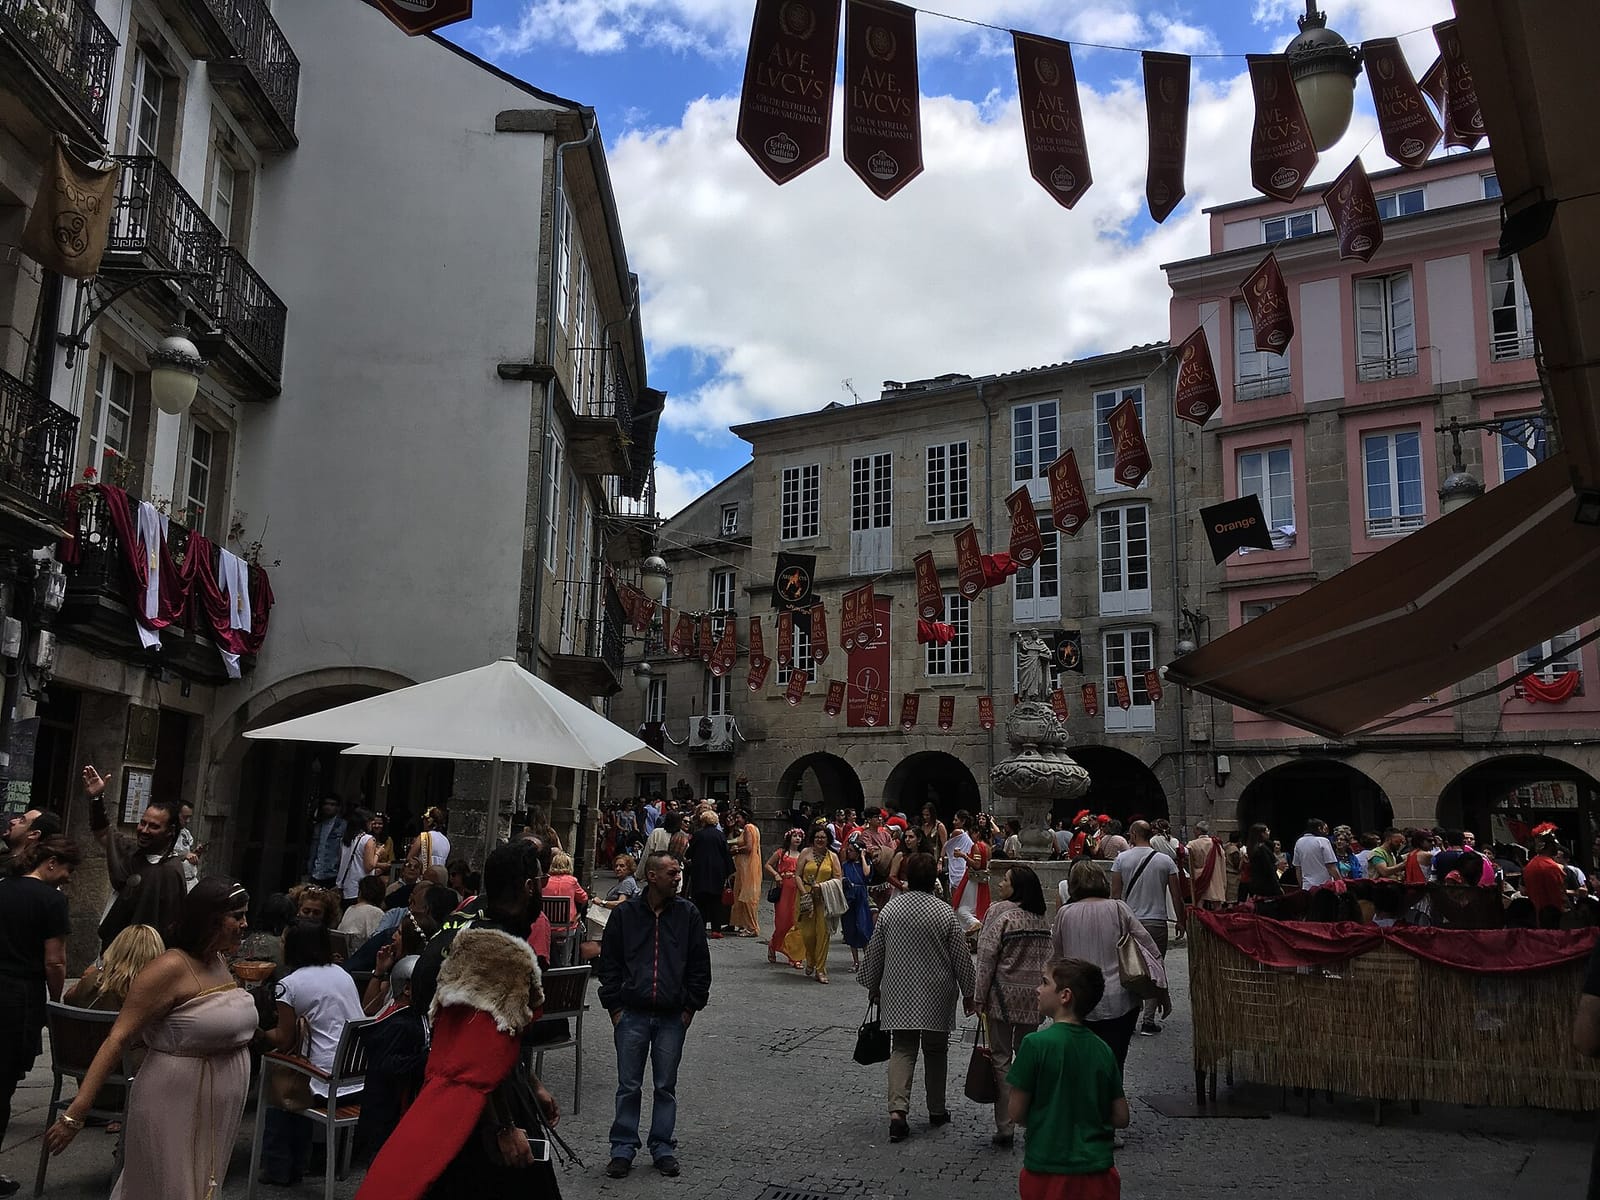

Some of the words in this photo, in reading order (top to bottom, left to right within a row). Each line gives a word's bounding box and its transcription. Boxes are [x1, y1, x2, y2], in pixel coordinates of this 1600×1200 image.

[769, 41, 816, 75] AVE,
[757, 62, 824, 99] LVCVS
[859, 64, 902, 93] AVE,
[853, 85, 911, 117] LVCVS
[1215, 516, 1257, 534] Orange
